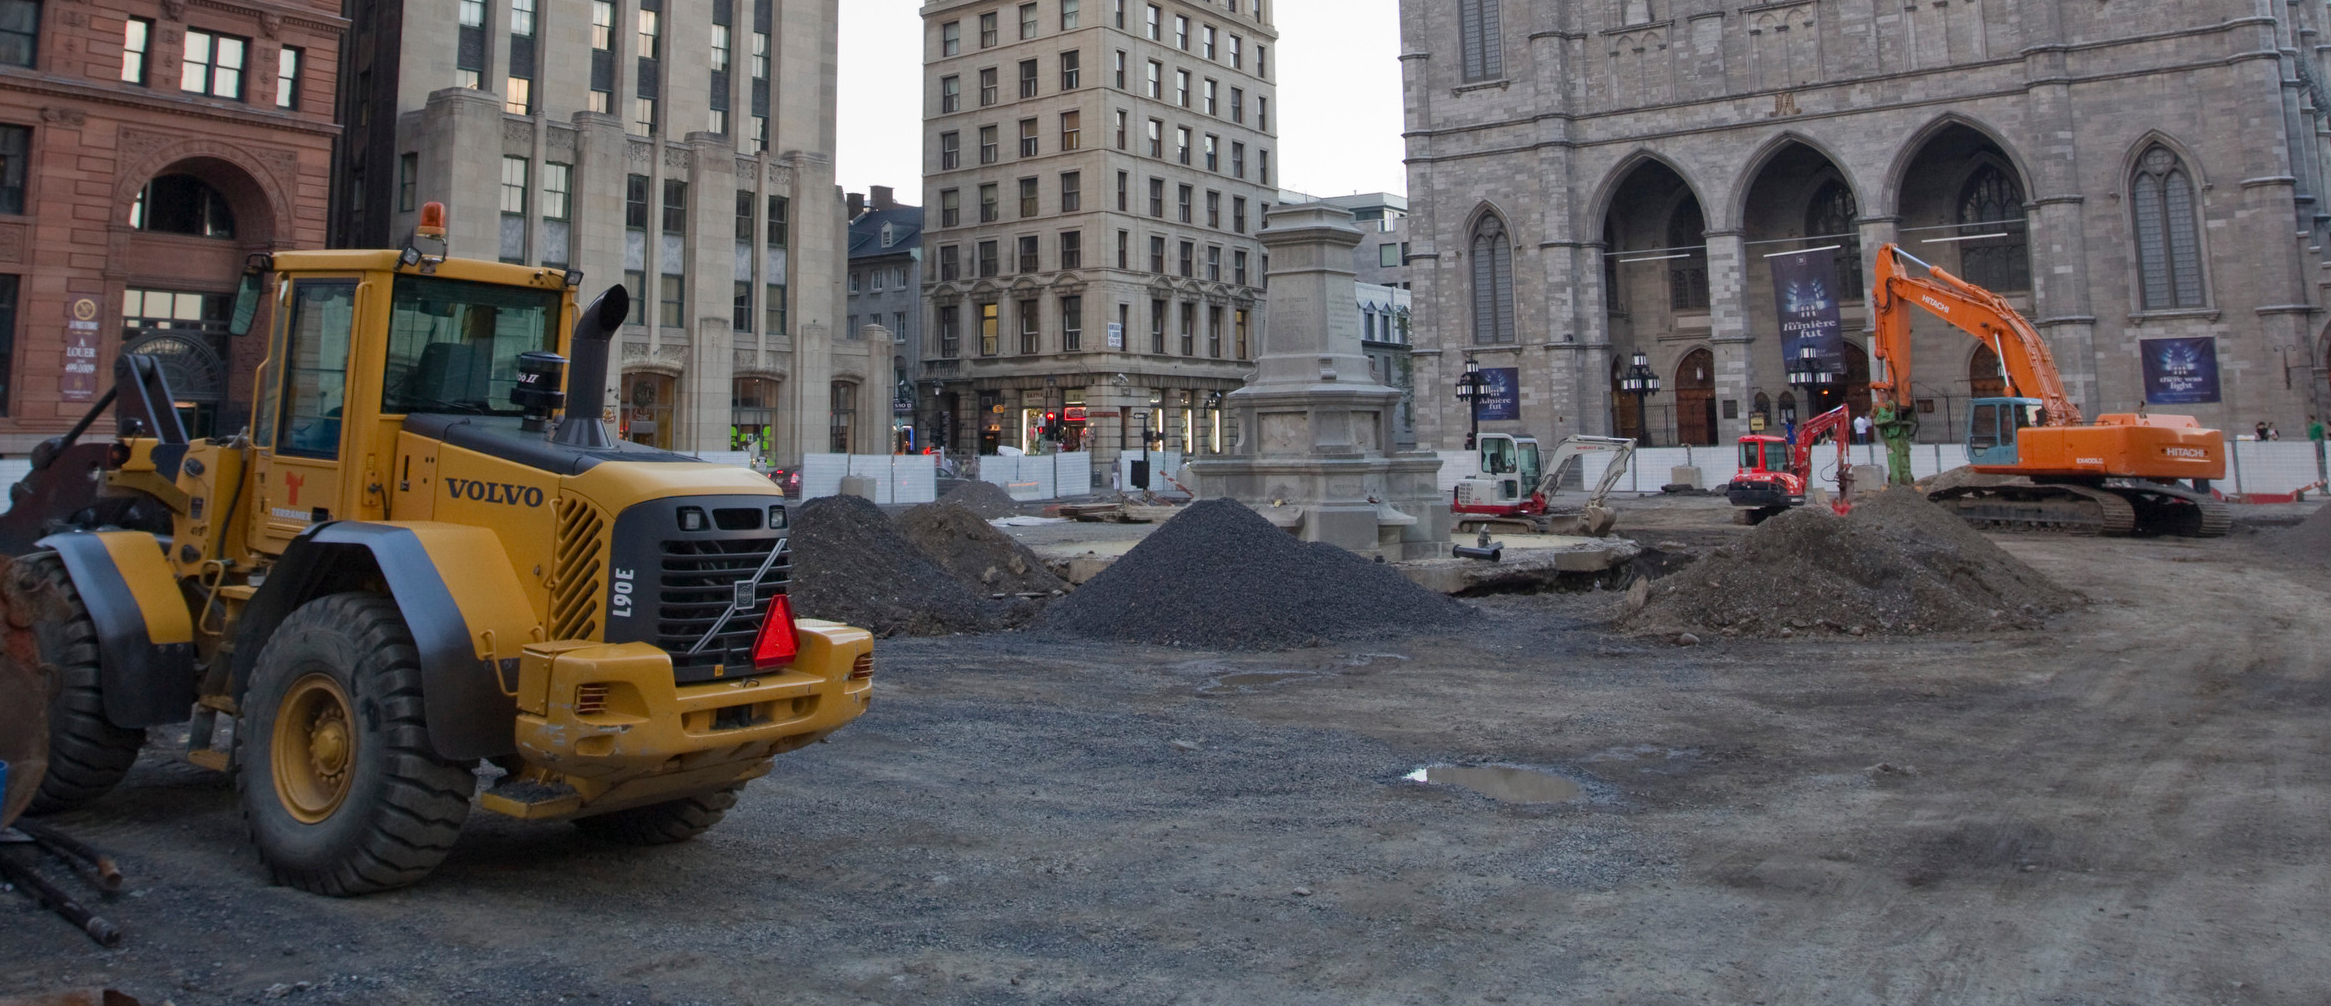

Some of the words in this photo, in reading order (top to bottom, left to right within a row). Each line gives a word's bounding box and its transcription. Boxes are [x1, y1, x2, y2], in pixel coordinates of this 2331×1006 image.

[1922, 294, 1950, 314] HITACHI
[1783, 320, 1837, 332] lumière
[1800, 328, 1824, 339] fut
[66, 347, 96, 358] LOUER
[2170, 382, 2194, 391] light
[2166, 447, 2205, 458] HITACHI
[444, 477, 544, 508] VOLVO
[612, 567, 635, 618] L90E
